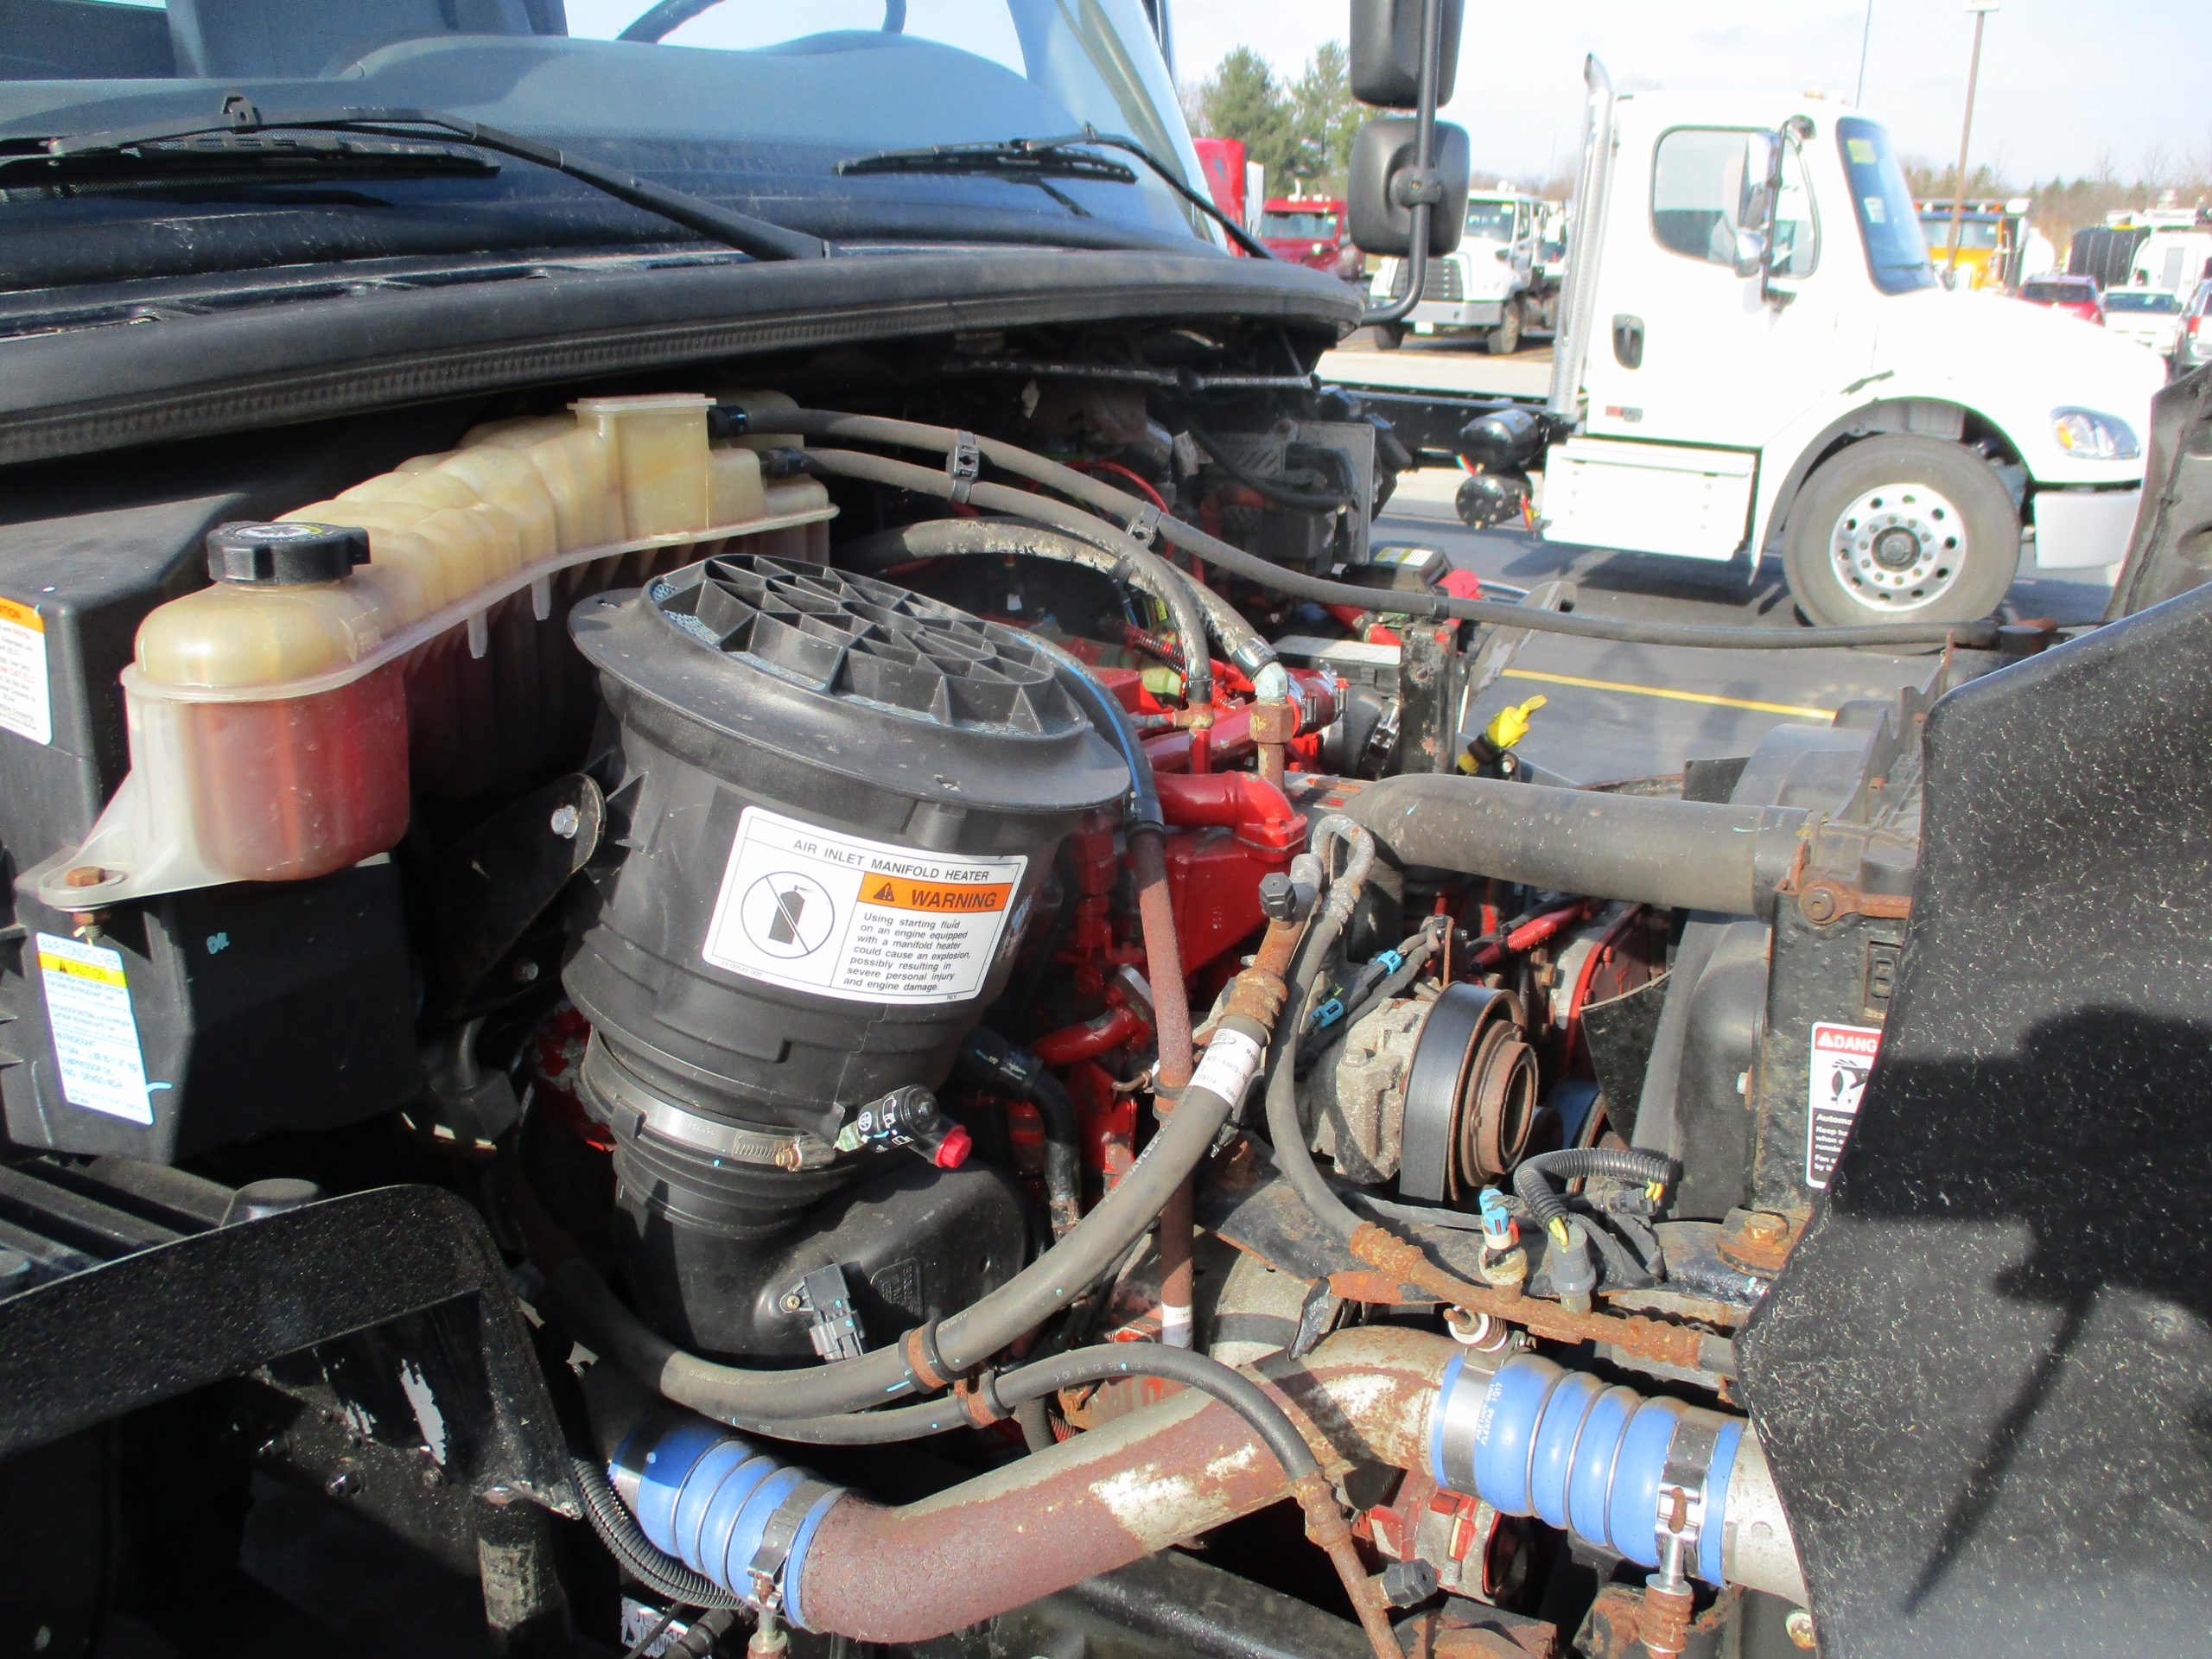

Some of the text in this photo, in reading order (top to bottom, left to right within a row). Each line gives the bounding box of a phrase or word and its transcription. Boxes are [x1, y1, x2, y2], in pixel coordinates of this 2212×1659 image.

[793, 839, 989, 881] AIR INLET MANIFOLD HEATER
[912, 889, 996, 908] WARNING
[864, 912, 960, 930] Using starting fluid
[857, 935, 877, 944] with
[893, 939, 932, 950] manifold
[894, 929, 926, 939] engine
[930, 931, 968, 941] equipped
[854, 946, 881, 956] could
[885, 950, 912, 959] cause
[849, 957, 893, 969] possibly
[899, 962, 938, 972] resulting
[847, 967, 955, 982] severe personal injury
[843, 978, 938, 993] and engine damage.
[1834, 1034, 1878, 1053] DANG
[1815, 1125, 1837, 1136] Keep
[1815, 1135, 1837, 1144] when
[1815, 1154, 1830, 1163] Fan
[1815, 1162, 1825, 1172] by
[1481, 1408, 1494, 1446] FLEXFAB
